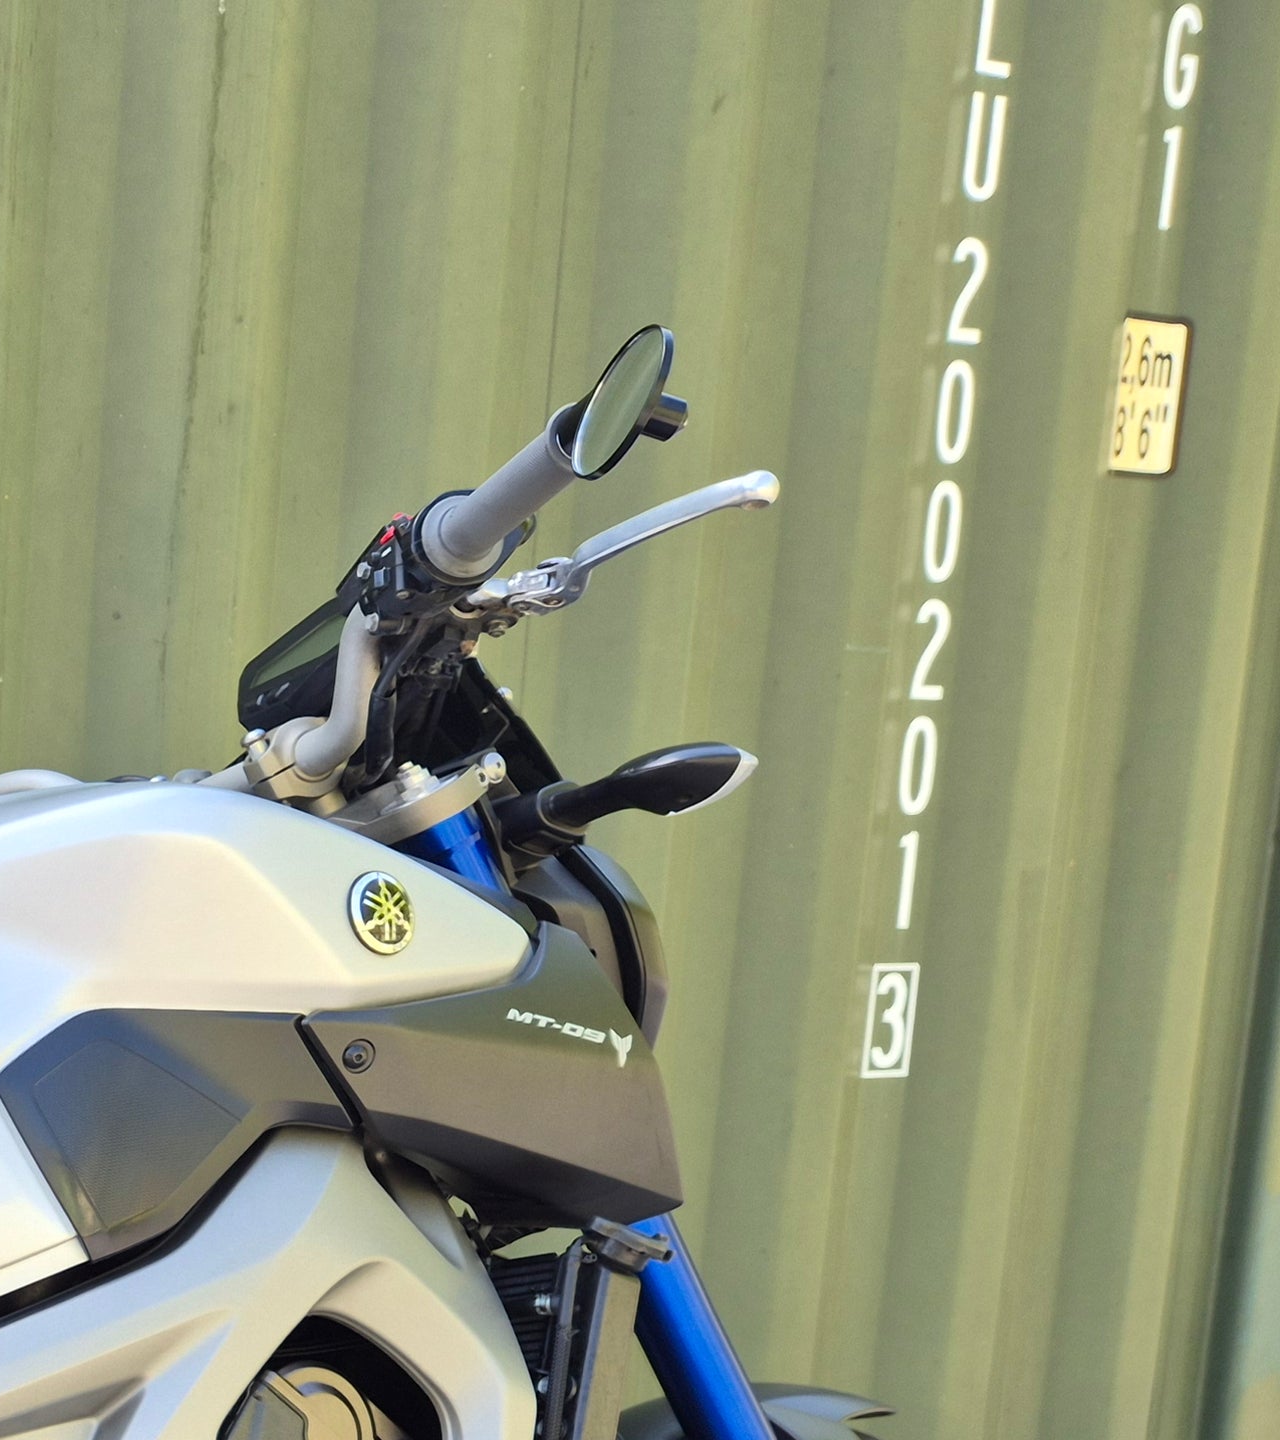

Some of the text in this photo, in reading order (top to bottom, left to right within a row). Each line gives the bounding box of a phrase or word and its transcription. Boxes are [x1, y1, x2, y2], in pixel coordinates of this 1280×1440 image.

[897, 236, 989, 930] 200201
[506, 1007, 607, 1044] MT-09
[869, 970, 910, 1071] 3
